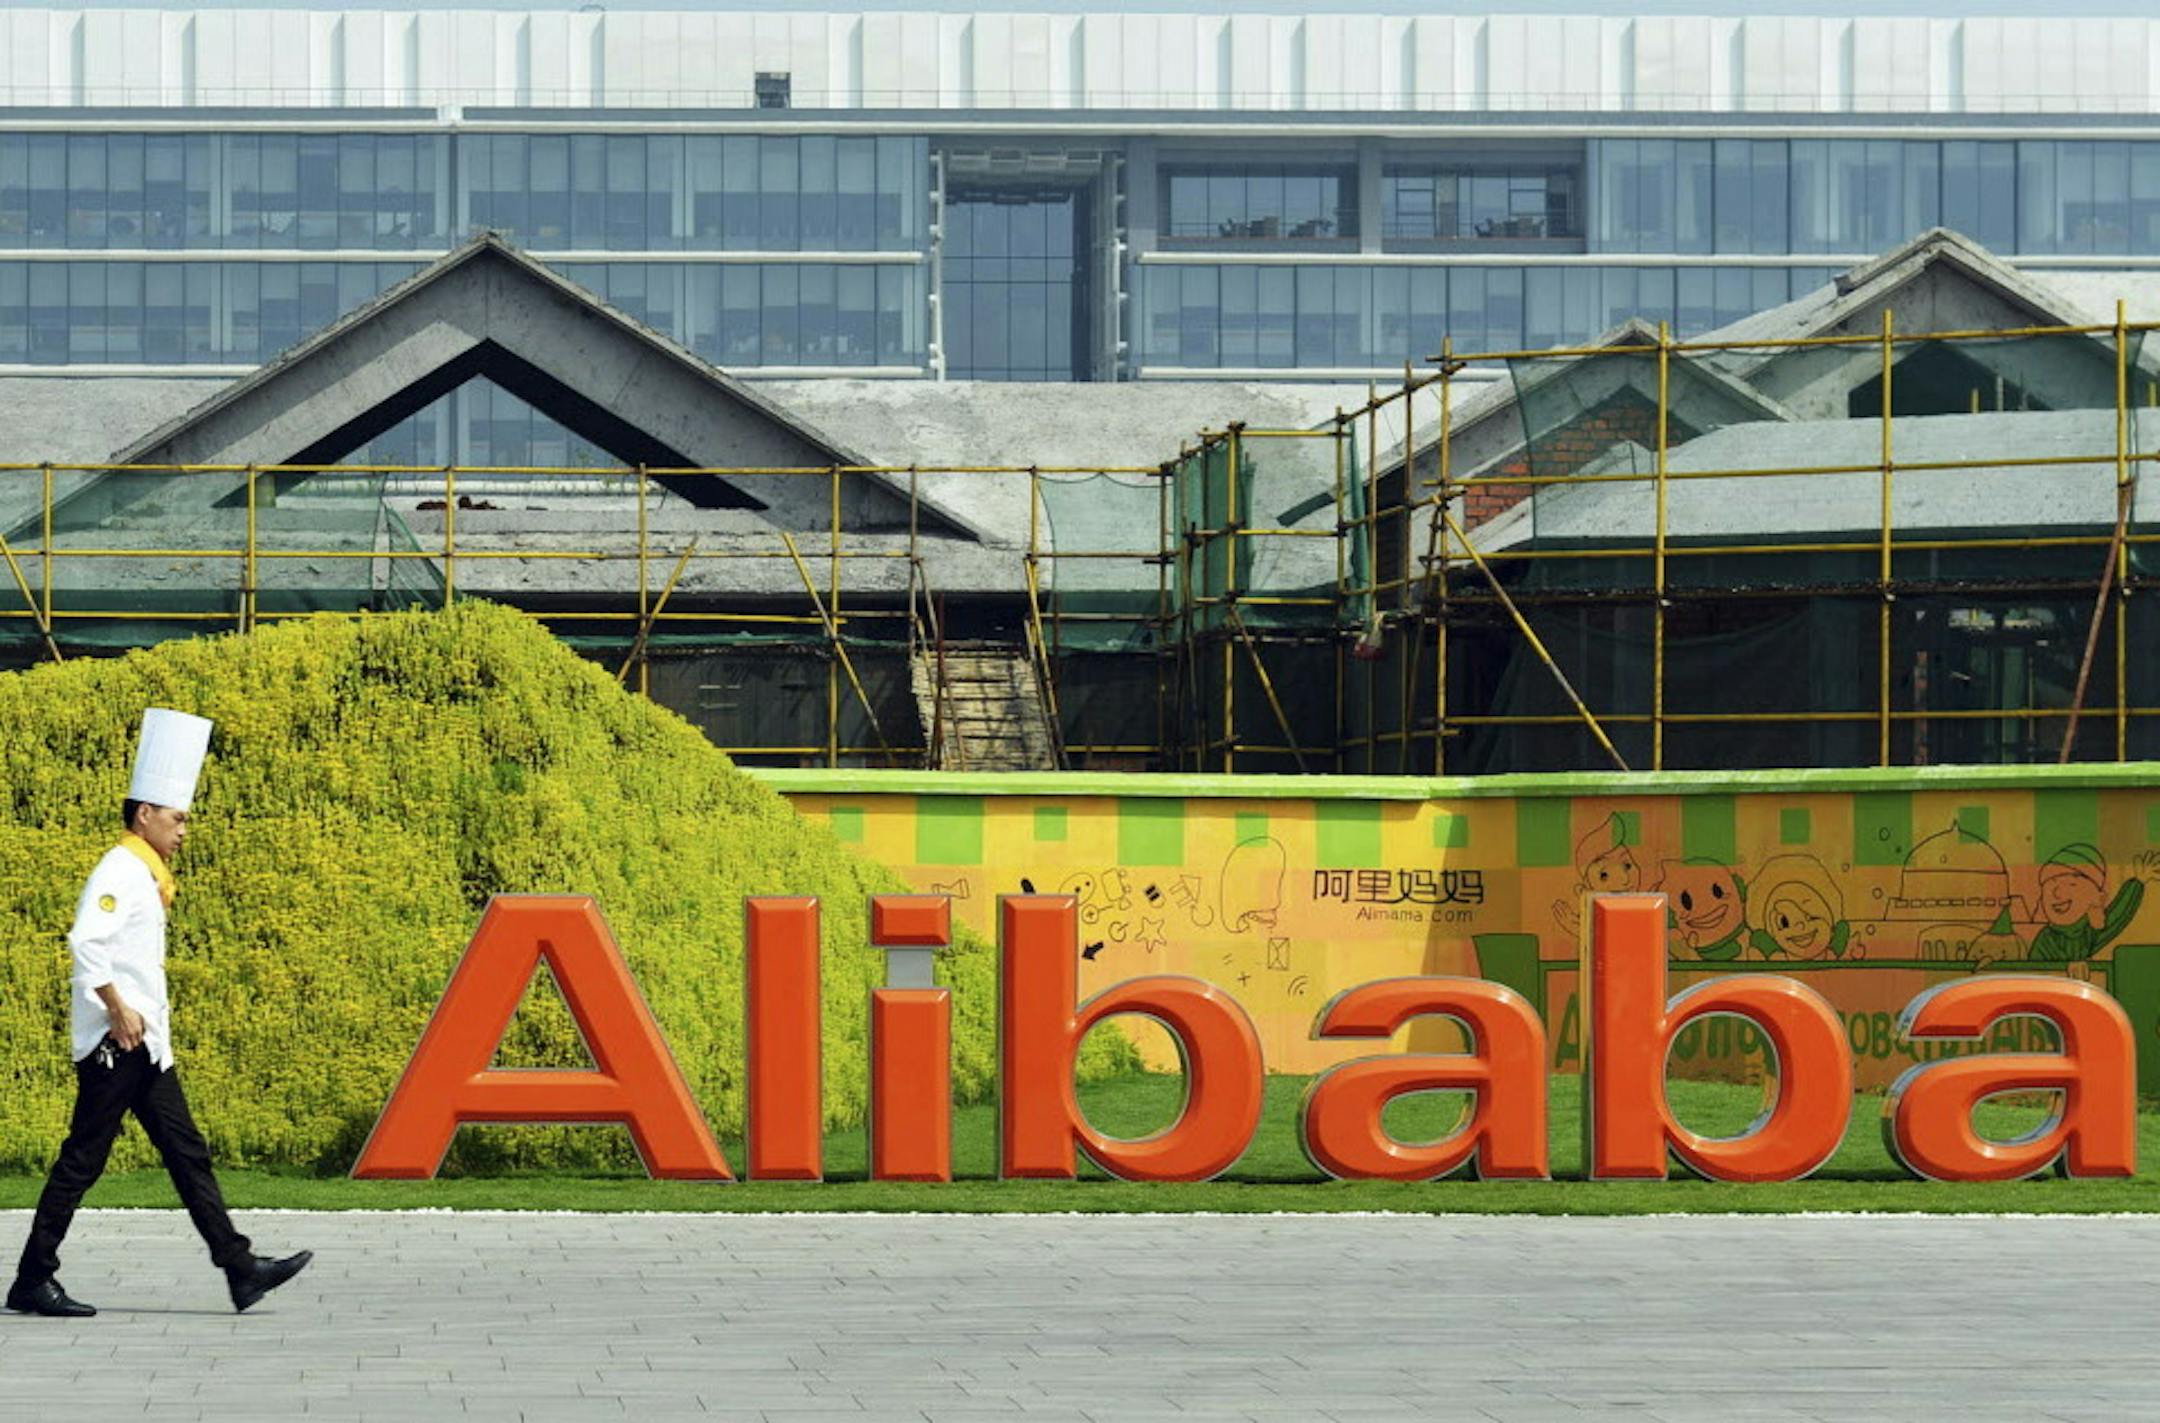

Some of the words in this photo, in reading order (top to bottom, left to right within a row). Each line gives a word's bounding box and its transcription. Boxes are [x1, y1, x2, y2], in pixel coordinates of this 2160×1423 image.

[1313, 868, 1484, 904] 阿里妈妈
[350, 891, 2136, 1181] Alibaba
